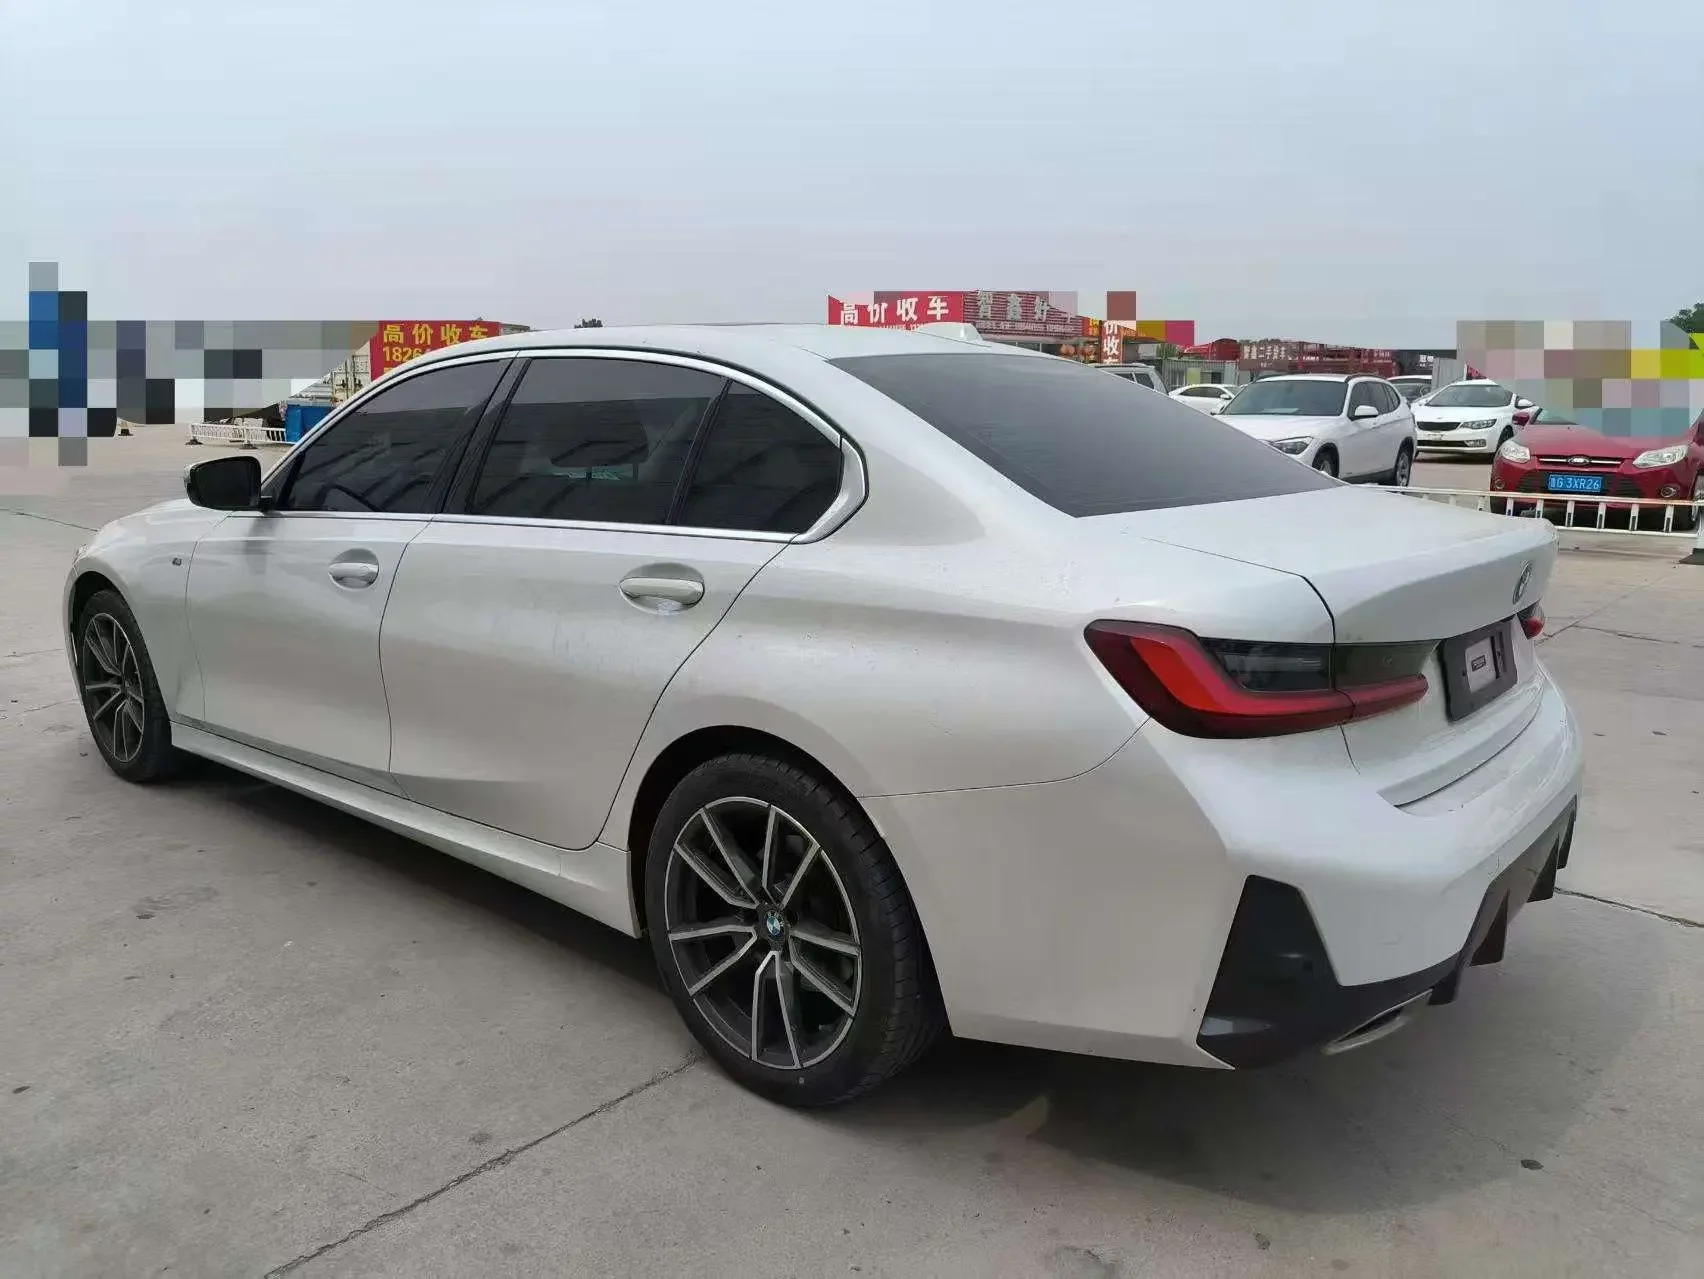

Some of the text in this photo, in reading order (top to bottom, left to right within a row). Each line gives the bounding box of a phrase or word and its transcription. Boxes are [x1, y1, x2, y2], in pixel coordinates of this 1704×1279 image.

[840, 296, 949, 325] 高价收车
[977, 289, 1072, 324] 智鑫好
[383, 323, 488, 345] 高价收车
[383, 346, 431, 363] 1826
